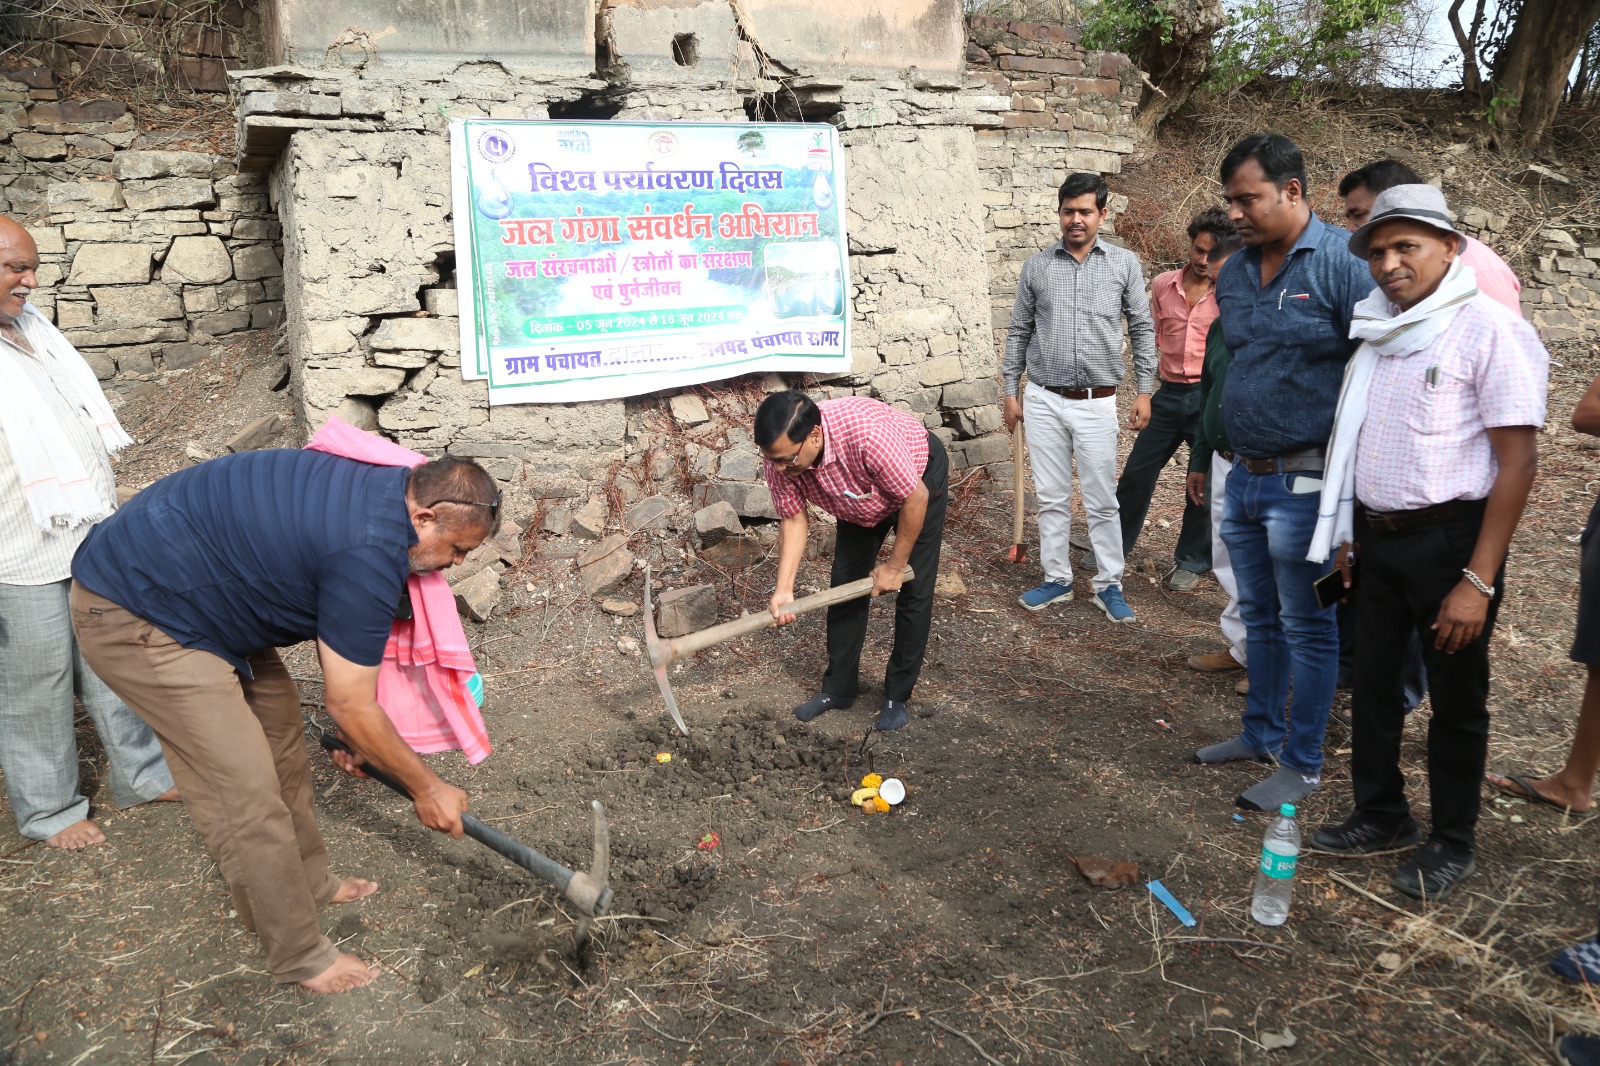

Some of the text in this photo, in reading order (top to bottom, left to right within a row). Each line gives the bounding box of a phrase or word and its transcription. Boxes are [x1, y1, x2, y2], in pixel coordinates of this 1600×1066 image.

[528, 161, 783, 193] विश्व पर्यावरण दिवस
[499, 203, 819, 245] जल गंगा संवर्धन अभियान
[505, 260, 537, 278] जल
[678, 254, 697, 270] का
[702, 246, 753, 269] संरक्षण
[591, 278, 613, 300] एवं
[530, 319, 564, 335] दिनांक
[576, 320, 592, 331] 05
[595, 320, 613, 334] जून
[616, 316, 645, 328] 2024
[646, 312, 658, 326] से
[661, 314, 675, 325] 16
[677, 312, 694, 327] जून
[696, 311, 724, 323] 2024
[751, 331, 803, 349] पंचायत
[504, 356, 539, 376] ग्राम
